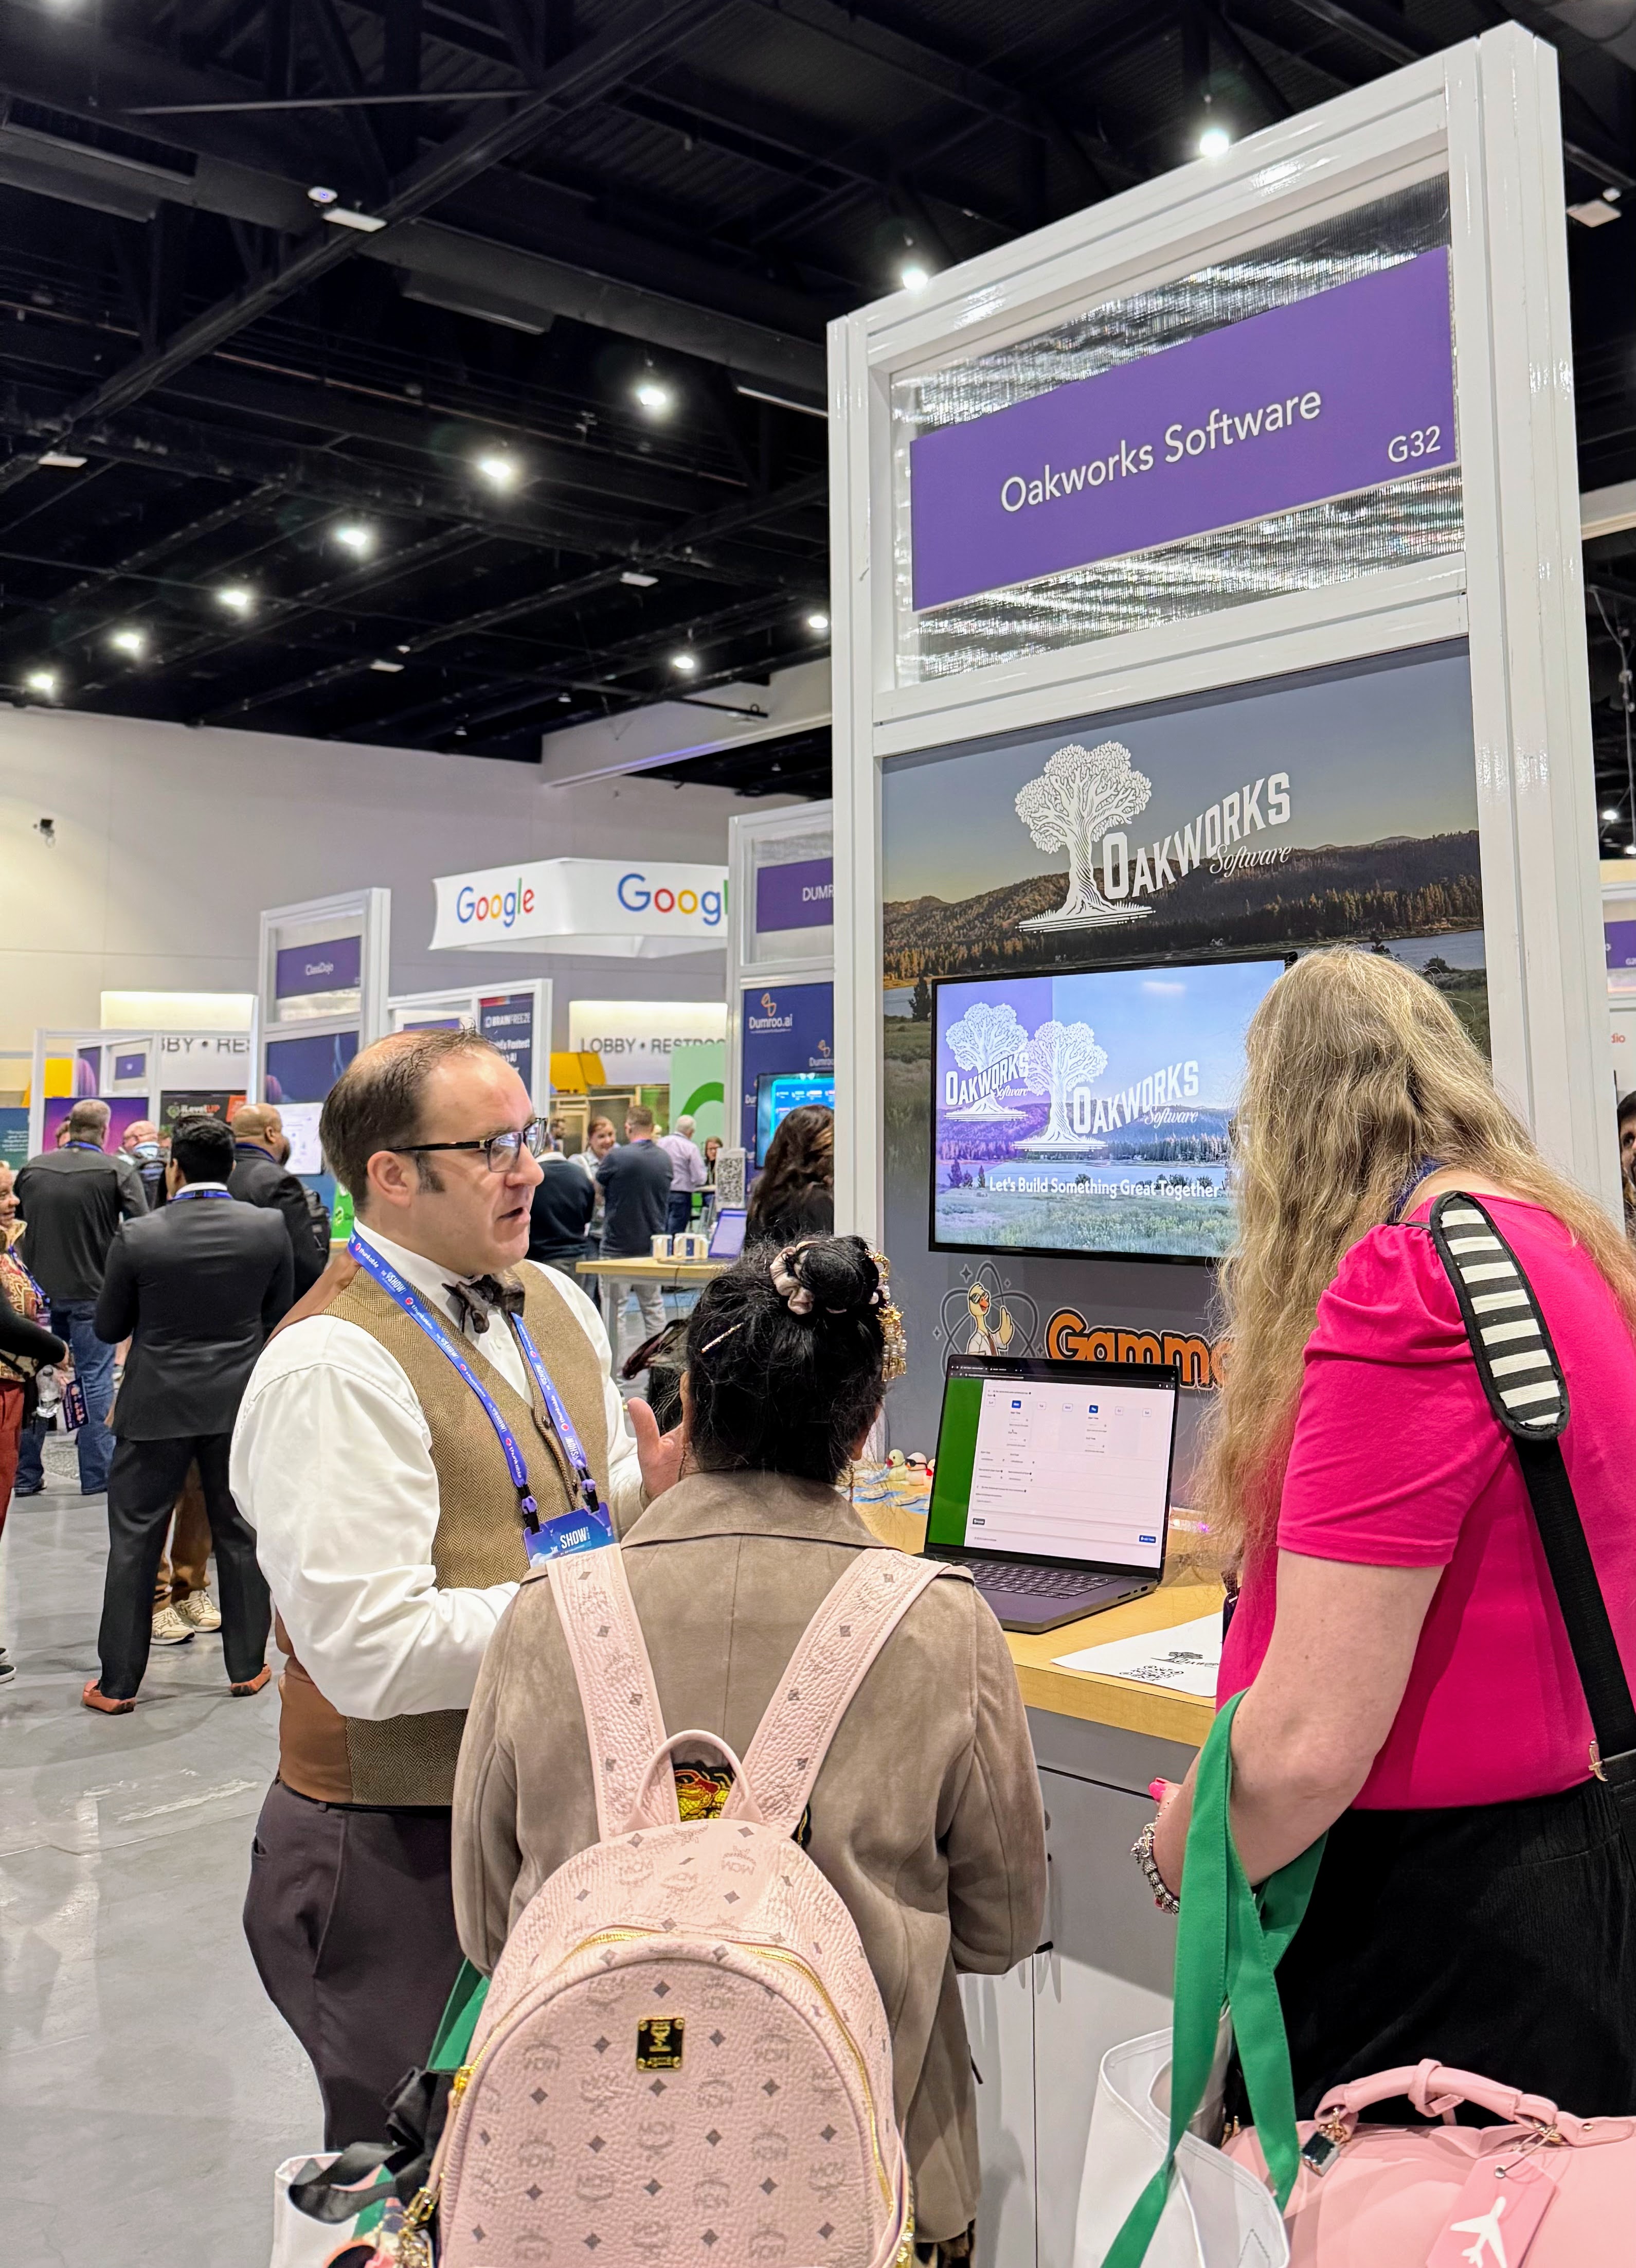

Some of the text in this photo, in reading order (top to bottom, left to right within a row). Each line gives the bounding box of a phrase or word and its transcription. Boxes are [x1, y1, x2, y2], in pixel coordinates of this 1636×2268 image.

[1001, 391, 1322, 512] Oakworks Software
[1388, 425, 1441, 462] G32
[1102, 772, 1290, 899] OAKWORKS
[1210, 844, 1292, 878] Software
[457, 878, 534, 927] Google
[749, 1013, 793, 1029] Dumroo.ai
[163, 1037, 249, 1053] BY RE
[581, 1038, 636, 1053] LOBBY
[945, 1052, 1029, 1105] OAKWORKS
[1073, 1060, 1199, 1134] OAKWORKS
[1144, 1105, 1199, 1129] Software
[990, 1176, 1219, 1201] Let's Build Something Great Together
[560, 1527, 587, 1549] SHOW
